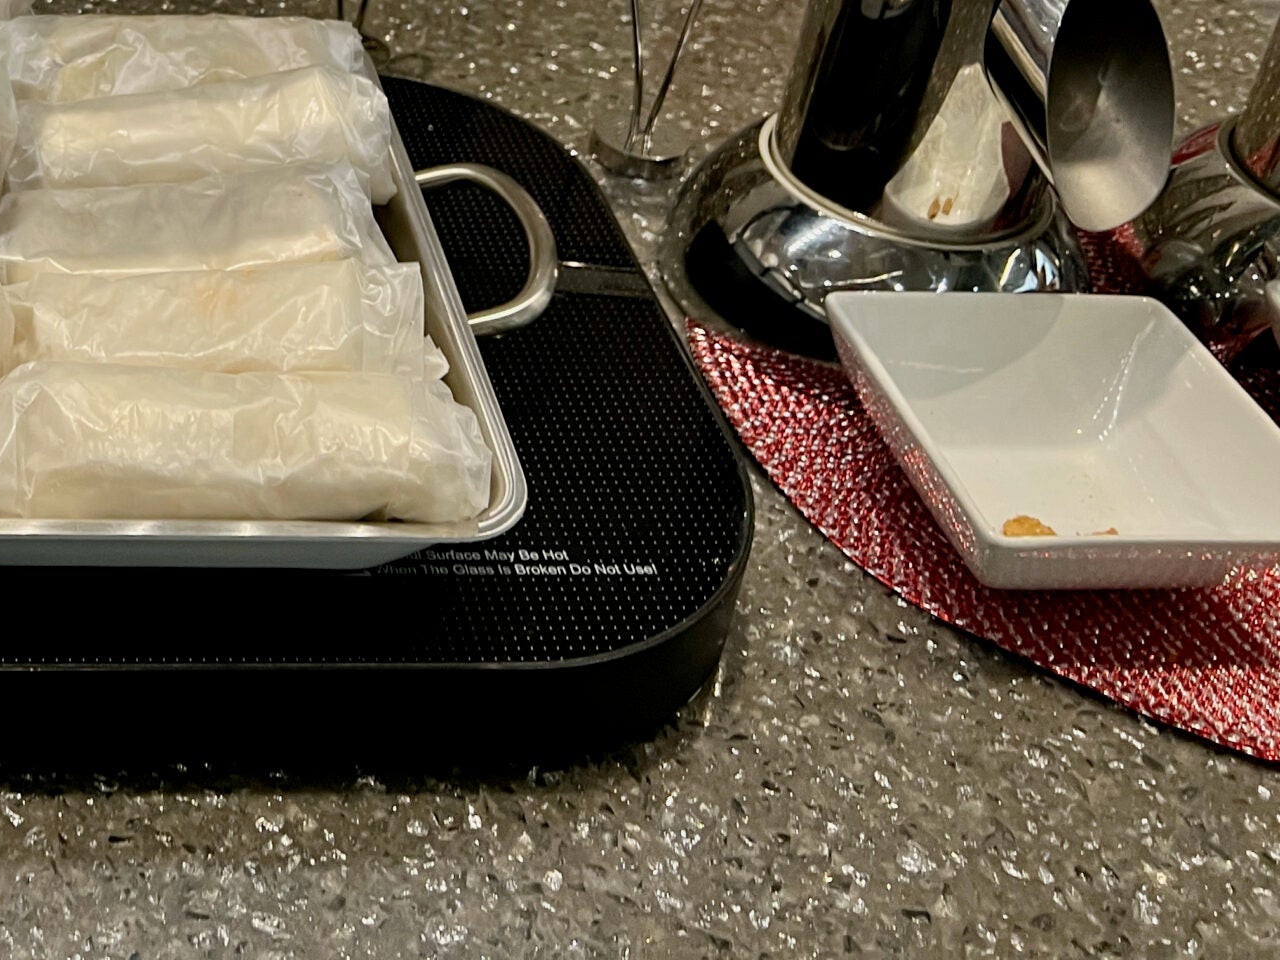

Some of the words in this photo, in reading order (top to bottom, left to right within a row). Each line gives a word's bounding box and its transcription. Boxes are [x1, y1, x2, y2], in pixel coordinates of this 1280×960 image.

[425, 549, 481, 561] Surface
[484, 549, 515, 563] May
[518, 549, 540, 561] Be
[542, 549, 570, 561] Hot
[420, 563, 449, 576] The
[452, 563, 495, 576] Glass
[497, 563, 512, 576] Is
[514, 563, 567, 576] Broken
[568, 563, 592, 576] Do
[593, 563, 622, 576] Not
[622, 562, 659, 576] Use!
